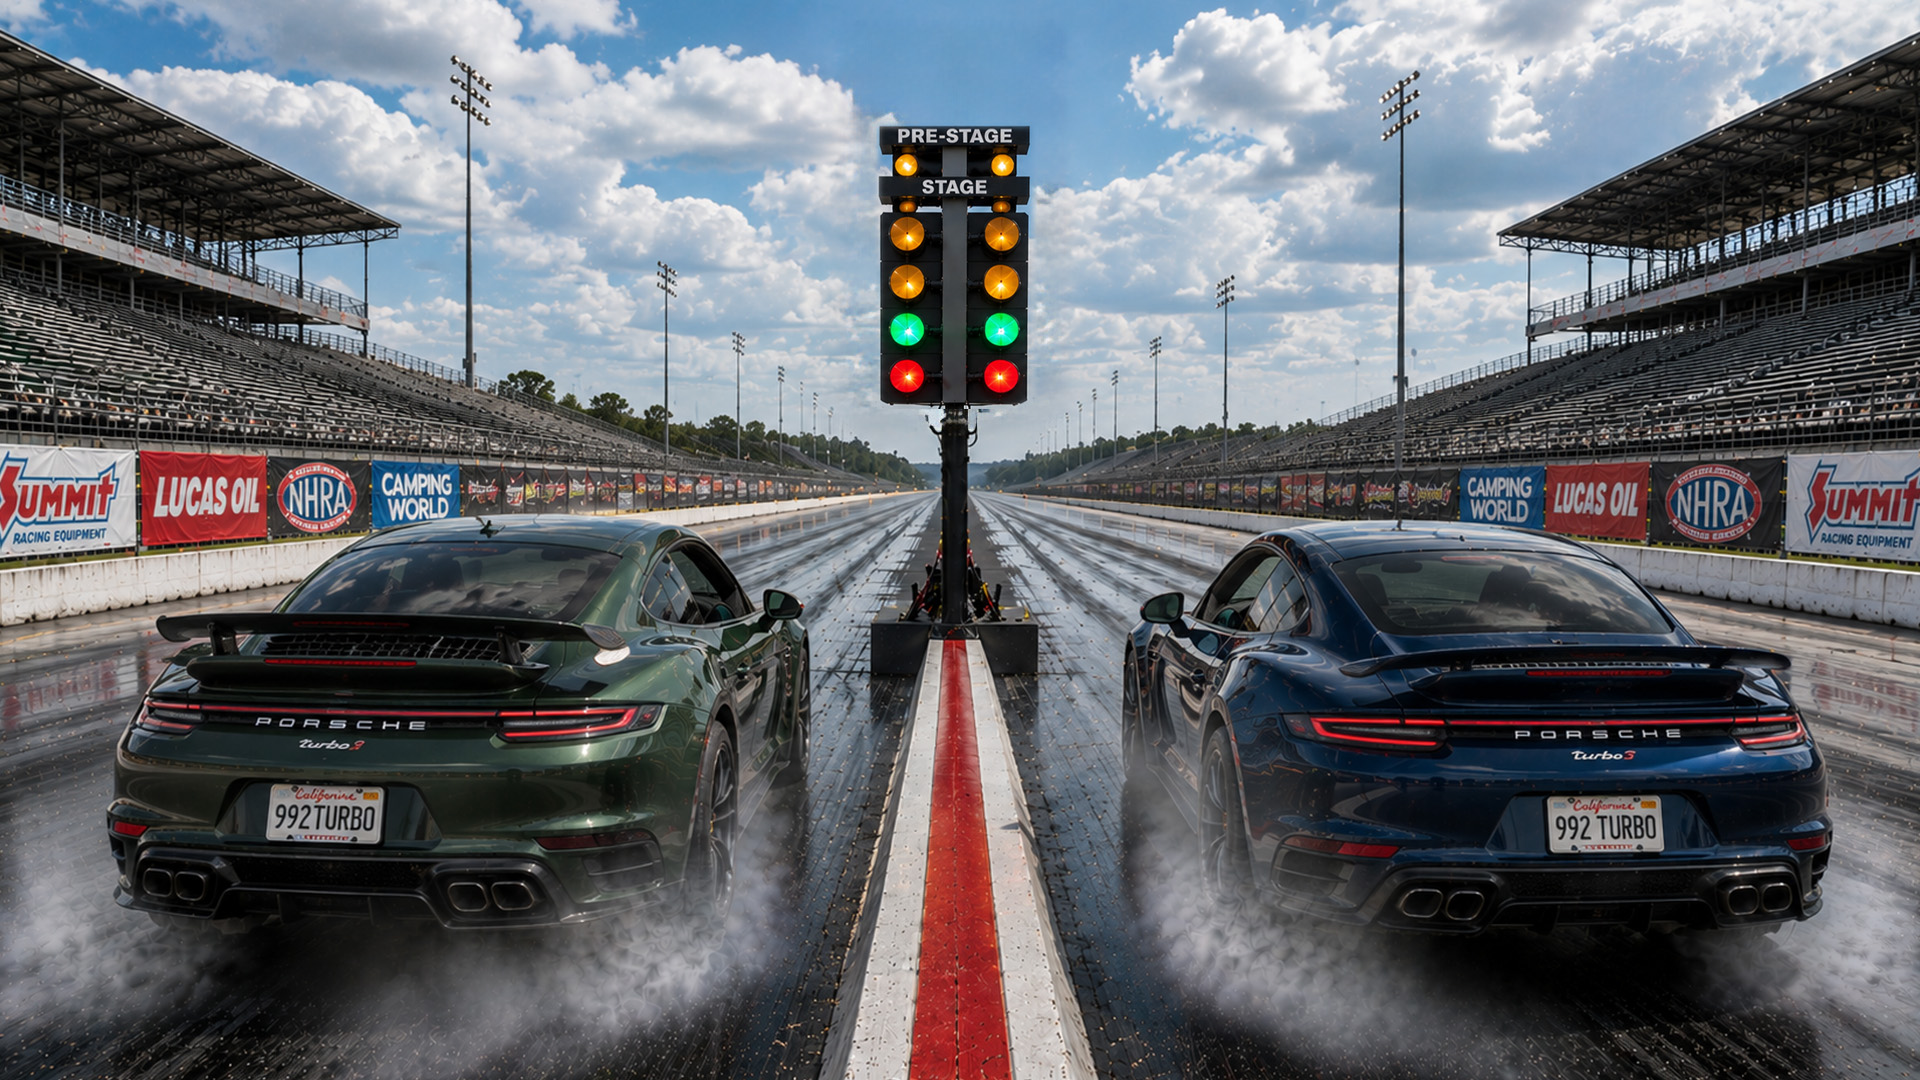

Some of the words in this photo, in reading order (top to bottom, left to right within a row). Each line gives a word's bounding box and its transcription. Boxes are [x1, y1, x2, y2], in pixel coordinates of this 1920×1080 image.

[897, 128, 1013, 144] PRE-STAGE
[922, 179, 987, 195] STAGE
[381, 472, 453, 496] CAMPING
[1467, 476, 1532, 498] CAMPING
[153, 476, 228, 517] LUCAS
[231, 477, 260, 514] OIL
[289, 477, 348, 518] NHRA
[1553, 482, 1607, 516] LUCAS
[1609, 482, 1639, 517] OIL
[1677, 480, 1748, 528] NHRA
[387, 497, 449, 521] WORLD
[1470, 499, 1529, 523] WORLD
[13, 530, 51, 545] RACING
[54, 528, 107, 541] EQUIPMENT
[1821, 532, 1854, 545] RACING
[1856, 535, 1914, 549] EQUIPMENT
[255, 717, 426, 731] PORSCHE
[1515, 729, 1681, 740] PORSCHE
[1556, 816, 1591, 840] 992
[1596, 815, 1657, 839] TURBO
